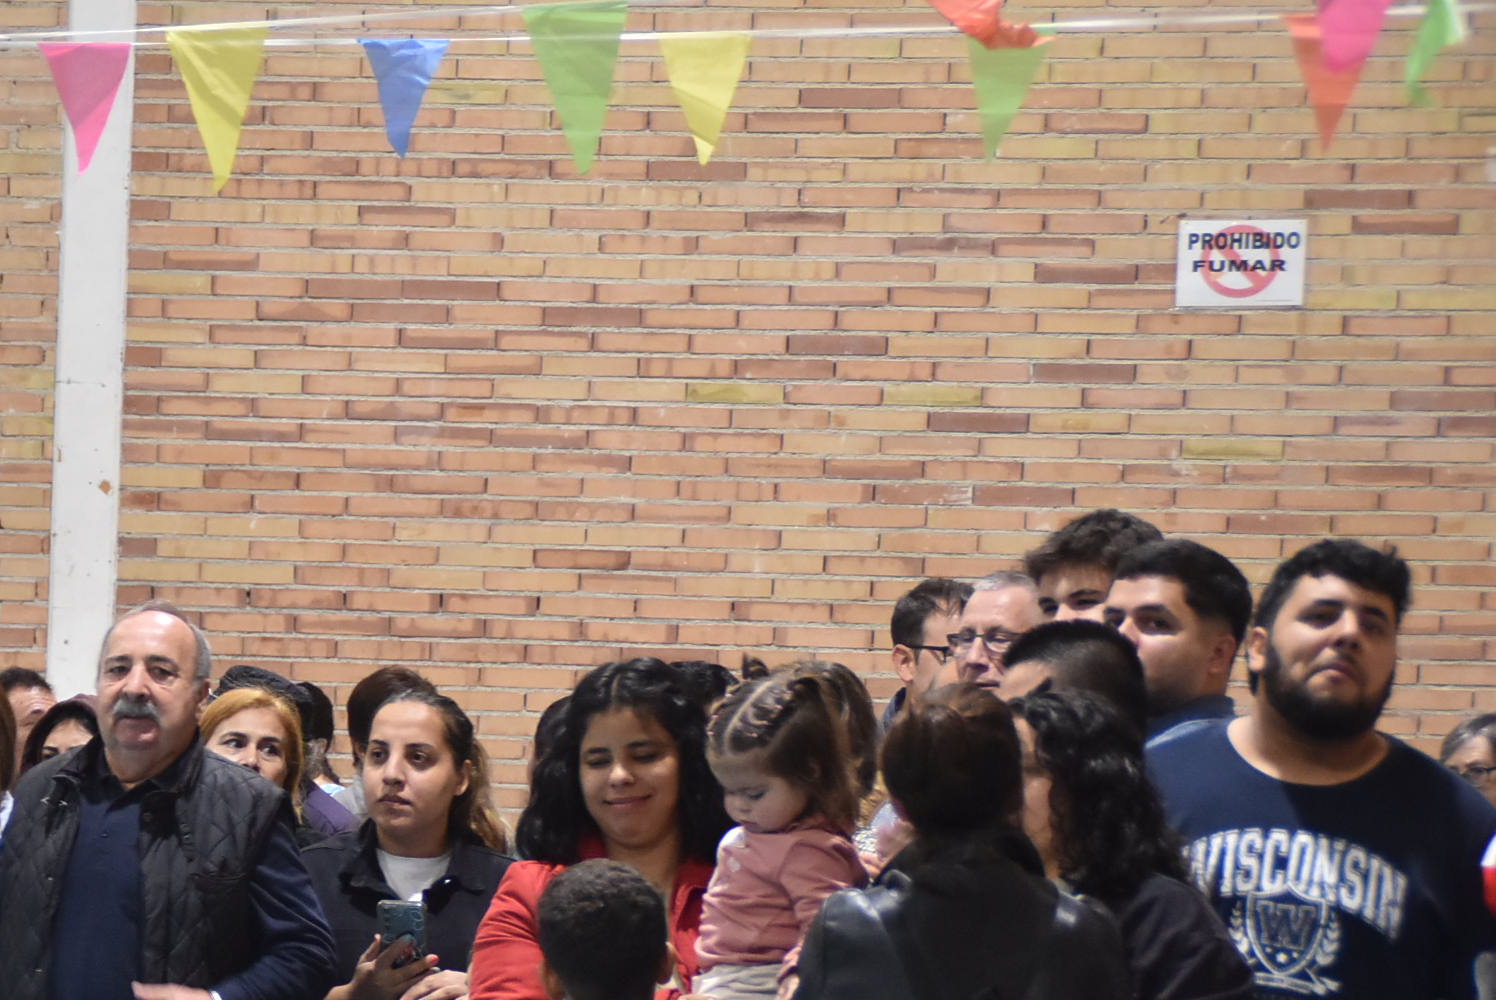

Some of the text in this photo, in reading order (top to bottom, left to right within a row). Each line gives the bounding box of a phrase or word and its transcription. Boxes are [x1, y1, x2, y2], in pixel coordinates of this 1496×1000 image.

[1188, 232, 1300, 250] PROHIBIDO
[1192, 260, 1286, 272] FUMAR
[1181, 826, 1408, 940] WISCONSIN
[1256, 899, 1316, 951] W
